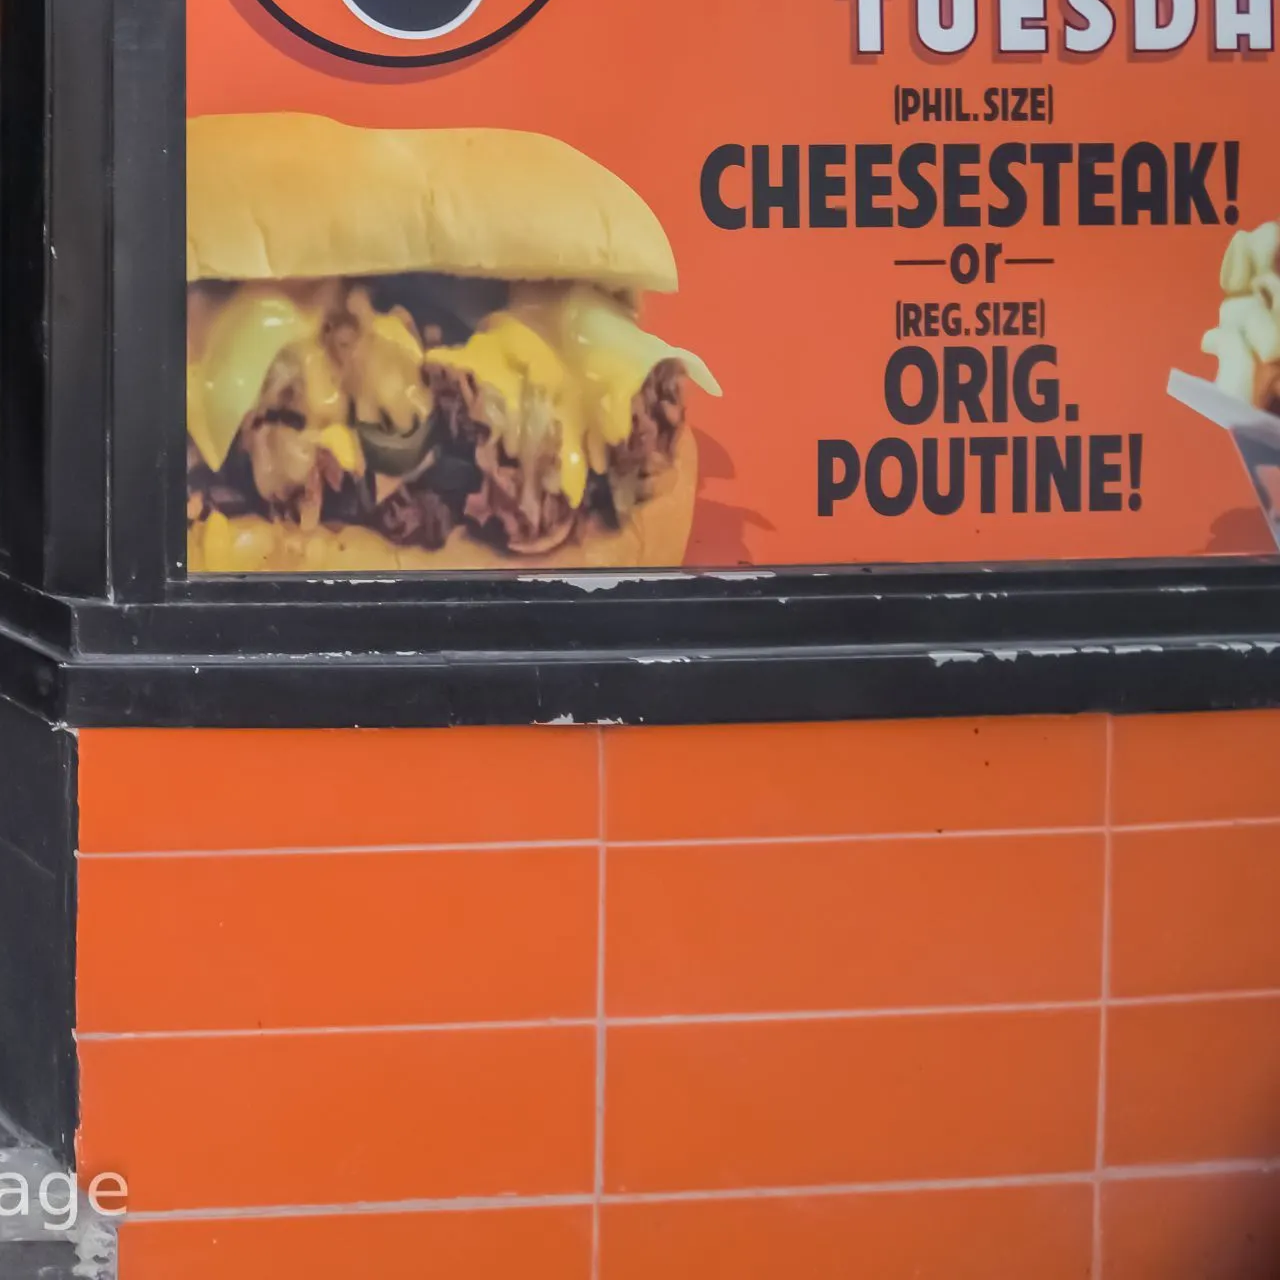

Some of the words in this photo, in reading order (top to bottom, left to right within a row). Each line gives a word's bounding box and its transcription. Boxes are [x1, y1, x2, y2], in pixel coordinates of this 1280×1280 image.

[700, 141, 1239, 230] CHEESESTEAK!
[884, 345, 1079, 425] ORIG.
[817, 433, 1143, 517] POUTINE!
